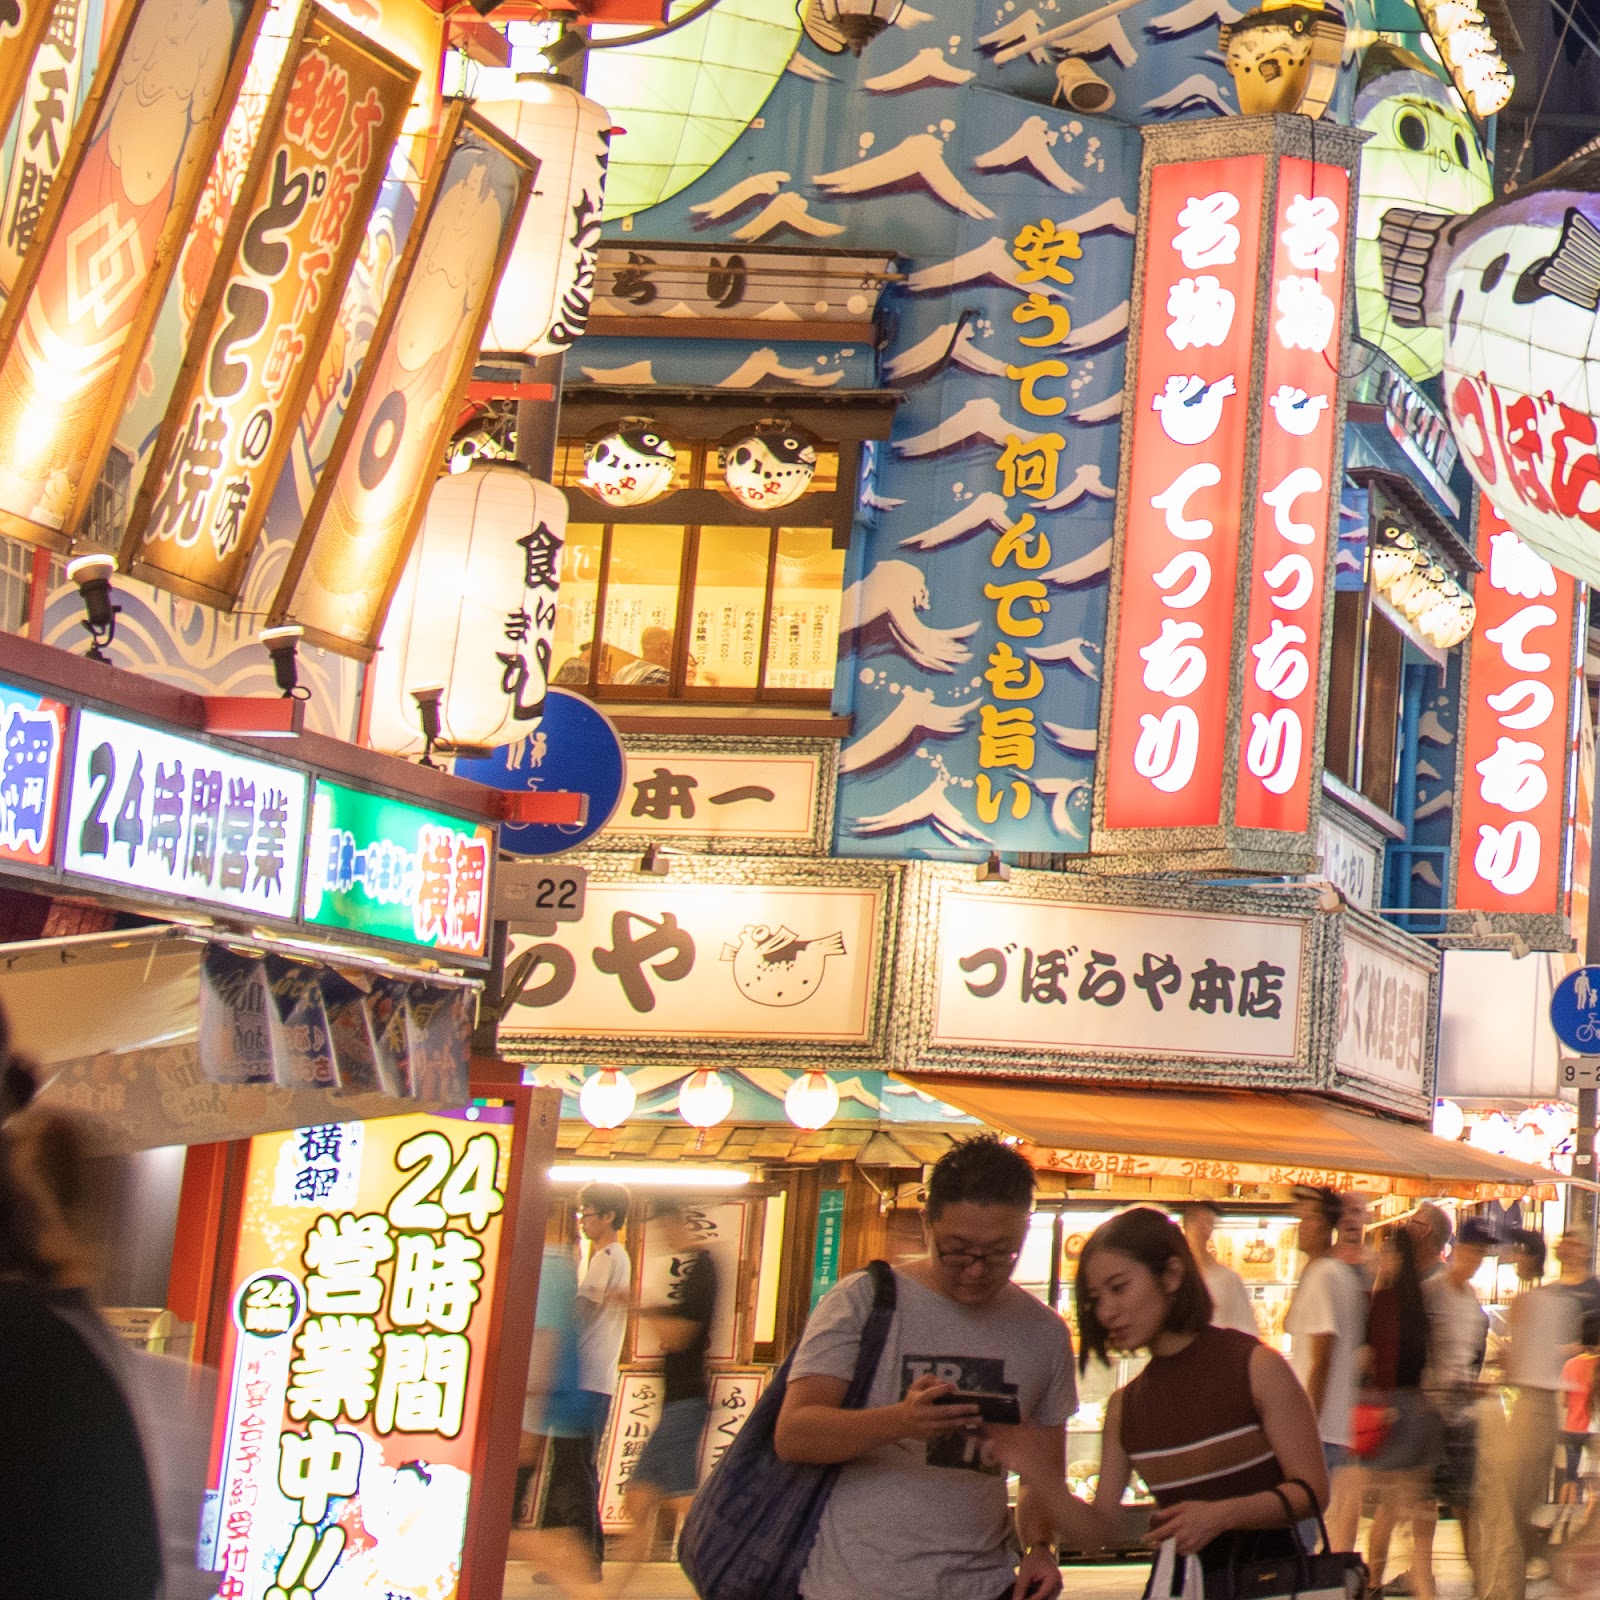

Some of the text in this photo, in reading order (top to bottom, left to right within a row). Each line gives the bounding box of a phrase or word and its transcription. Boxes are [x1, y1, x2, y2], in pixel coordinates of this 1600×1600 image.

[211, 90, 384, 560] 大阪下町の味
[1166, 191, 1241, 350] 名物
[975, 218, 1084, 824] 安うて何んでも旨い
[1133, 461, 1222, 794] てっちり
[1246, 466, 1325, 795] てっちり
[80, 741, 288, 898] 24時間営業
[535, 878, 578, 909] 22
[957, 943, 1287, 1022] づぼらや本店
[294, 1125, 343, 1202] 横綱
[374, 1131, 504, 1438] 24時間
